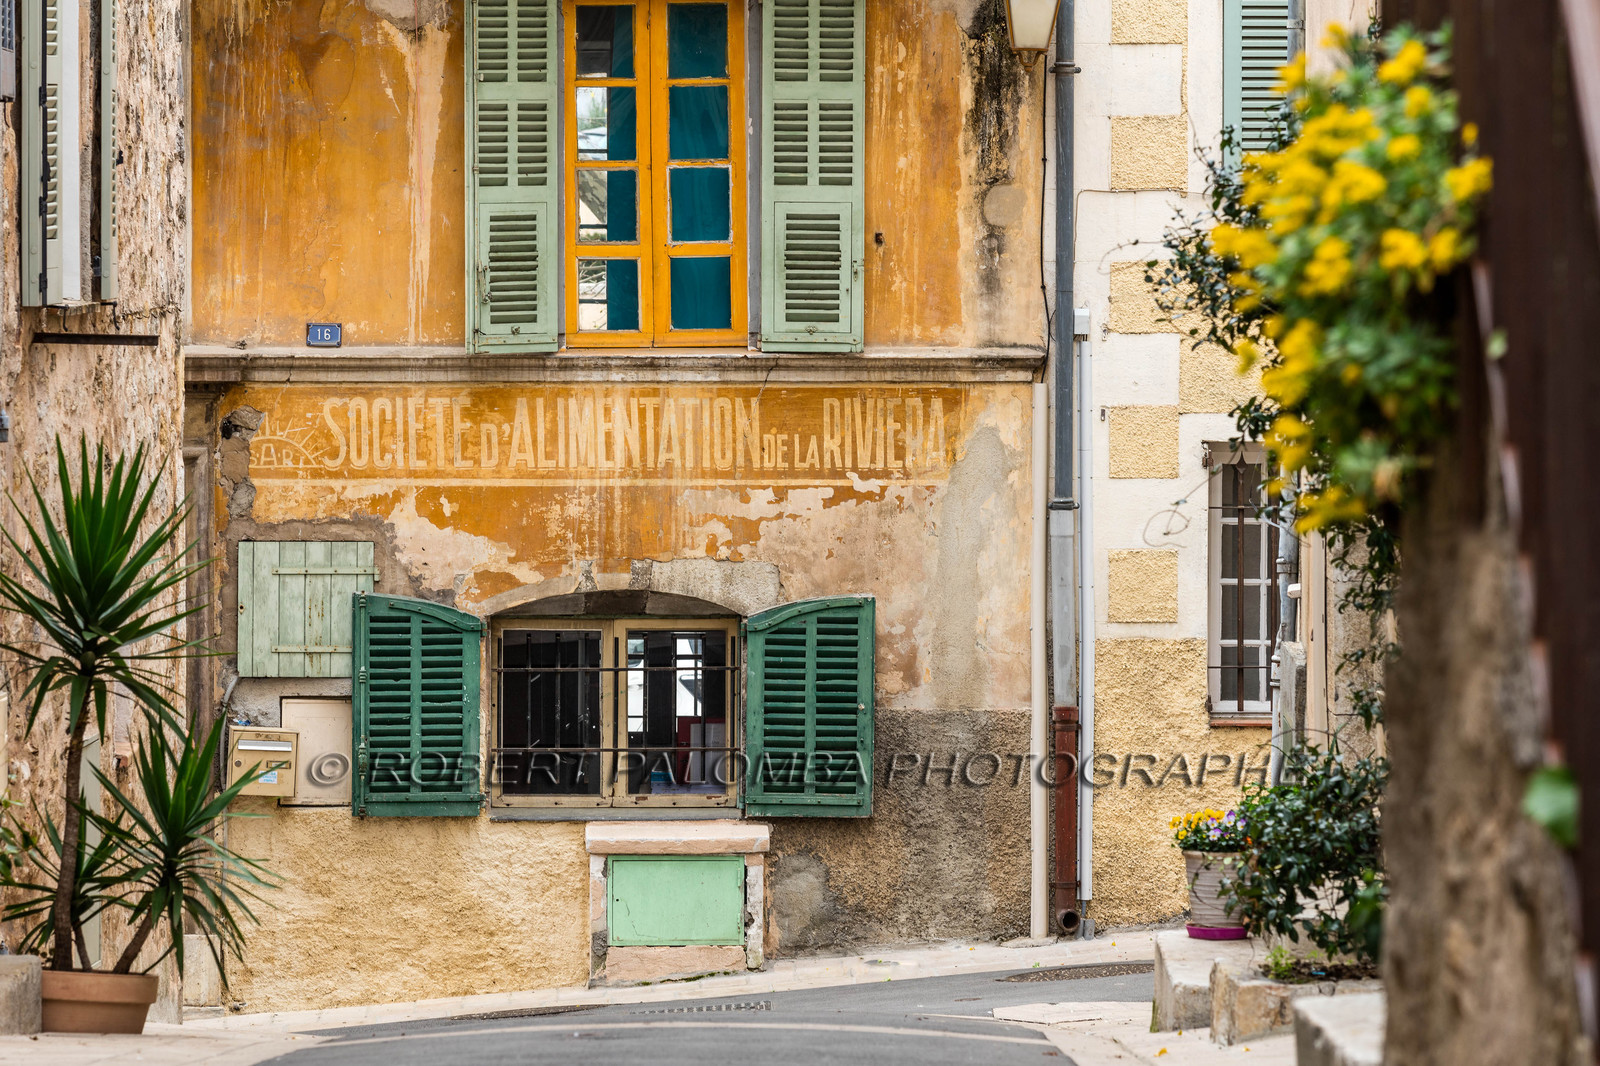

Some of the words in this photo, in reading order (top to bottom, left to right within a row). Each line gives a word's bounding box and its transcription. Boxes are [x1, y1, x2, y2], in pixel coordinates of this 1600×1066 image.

[317, 328, 331, 341] 16
[480, 396, 760, 470] D'ALIMENTATION
[763, 433, 789, 469] DE
[794, 434, 820, 469] LA
[823, 396, 946, 470] RIVIERA
